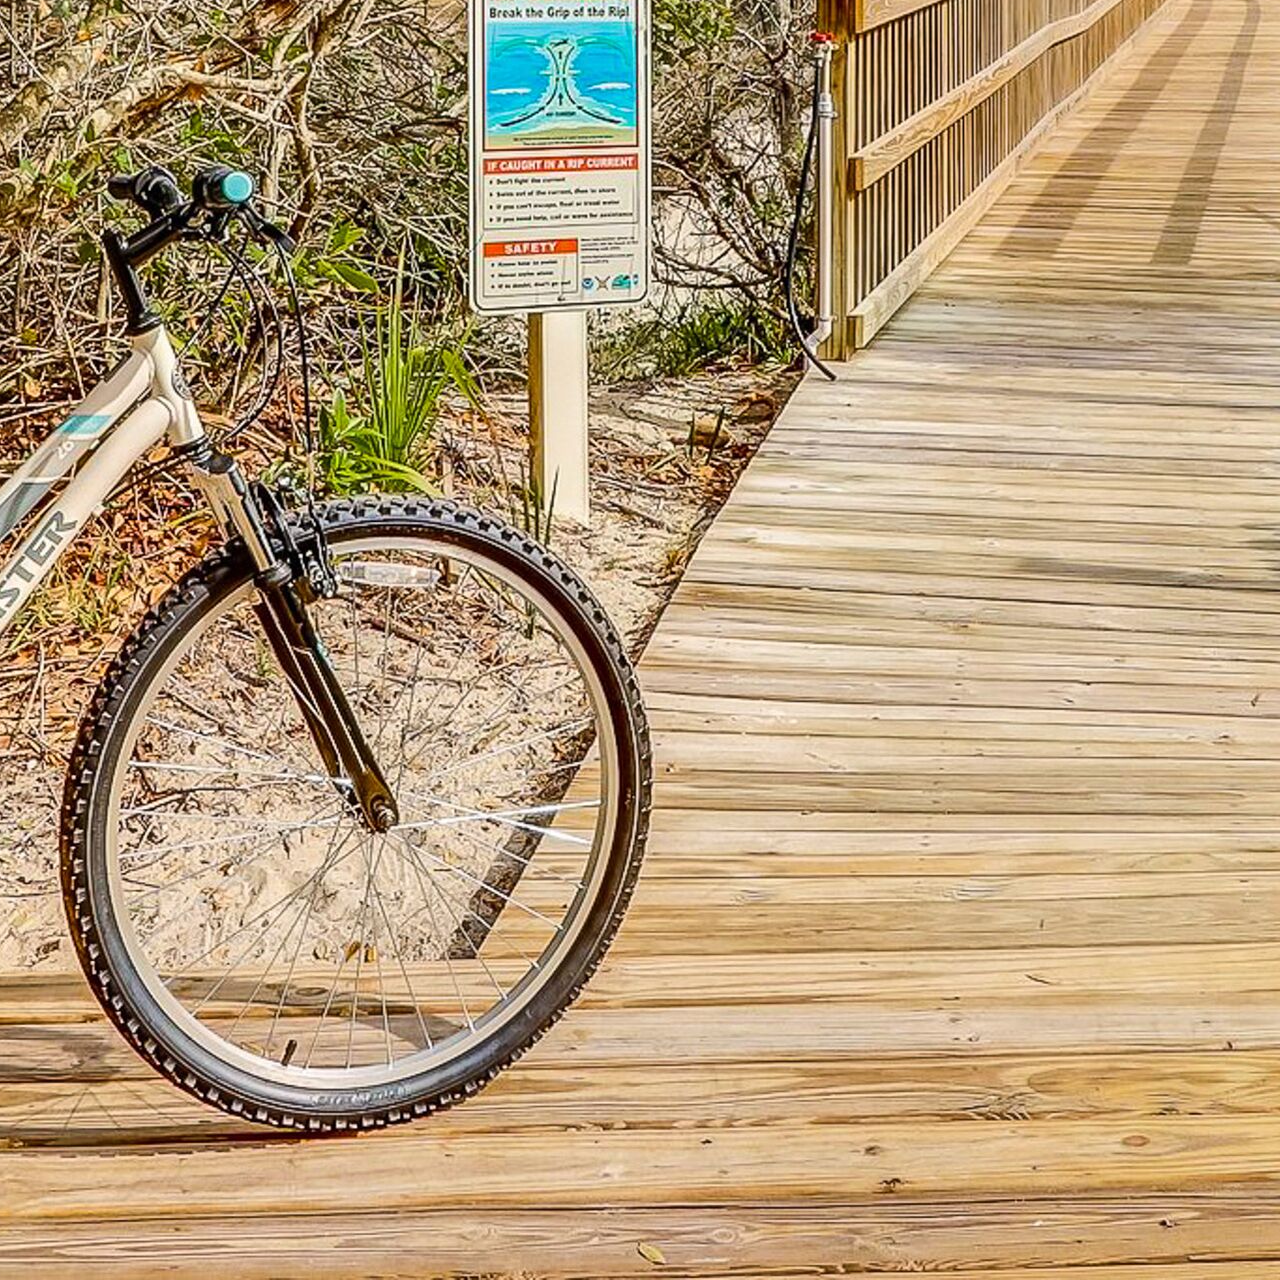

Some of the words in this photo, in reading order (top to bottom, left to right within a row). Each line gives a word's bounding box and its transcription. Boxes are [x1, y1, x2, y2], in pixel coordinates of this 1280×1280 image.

[489, 7, 522, 18] Break
[525, 7, 543, 18] the
[547, 6, 570, 19] Grip
[572, 6, 585, 17] of
[587, 6, 605, 17] the
[608, 6, 630, 19] Rip!
[487, 160, 497, 172] IF
[499, 160, 543, 171] CAUGHT
[544, 159, 555, 170] IN
[557, 159, 566, 170] A
[504, 241, 558, 254] SAFETY
